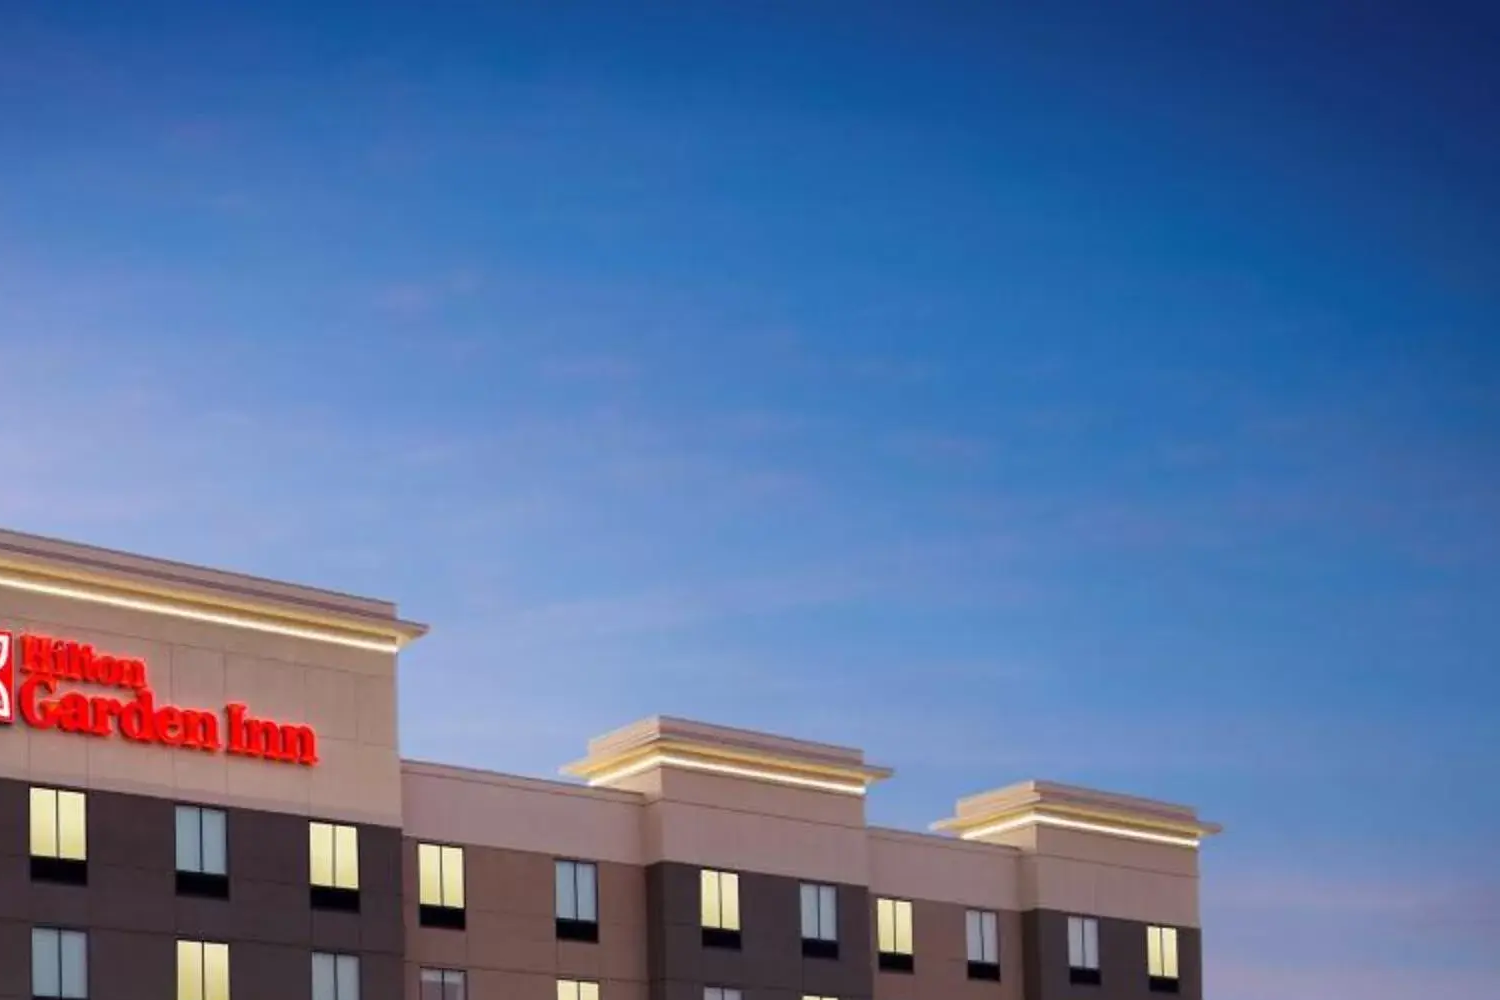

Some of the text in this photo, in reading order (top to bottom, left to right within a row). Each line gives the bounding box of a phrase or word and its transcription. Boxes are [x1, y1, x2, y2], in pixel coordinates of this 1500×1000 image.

[20, 633, 146, 688] Hilton
[19, 676, 318, 766] Garden Inn
